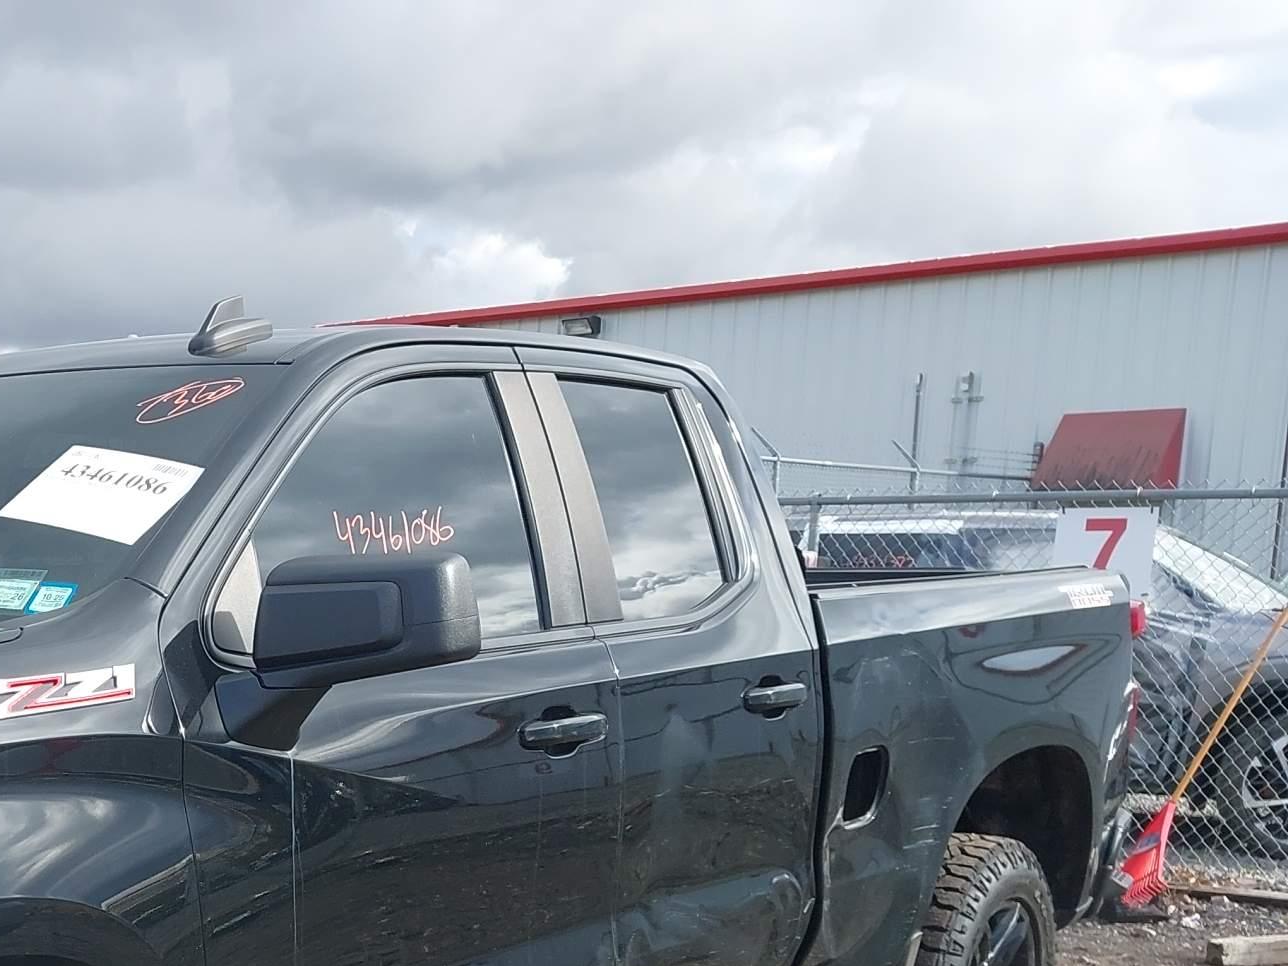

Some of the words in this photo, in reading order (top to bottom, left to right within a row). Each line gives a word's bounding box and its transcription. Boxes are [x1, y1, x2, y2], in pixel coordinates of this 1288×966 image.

[60, 463, 172, 496] 43461086
[332, 506, 454, 554] 43461086
[1085, 518, 1129, 570] 7
